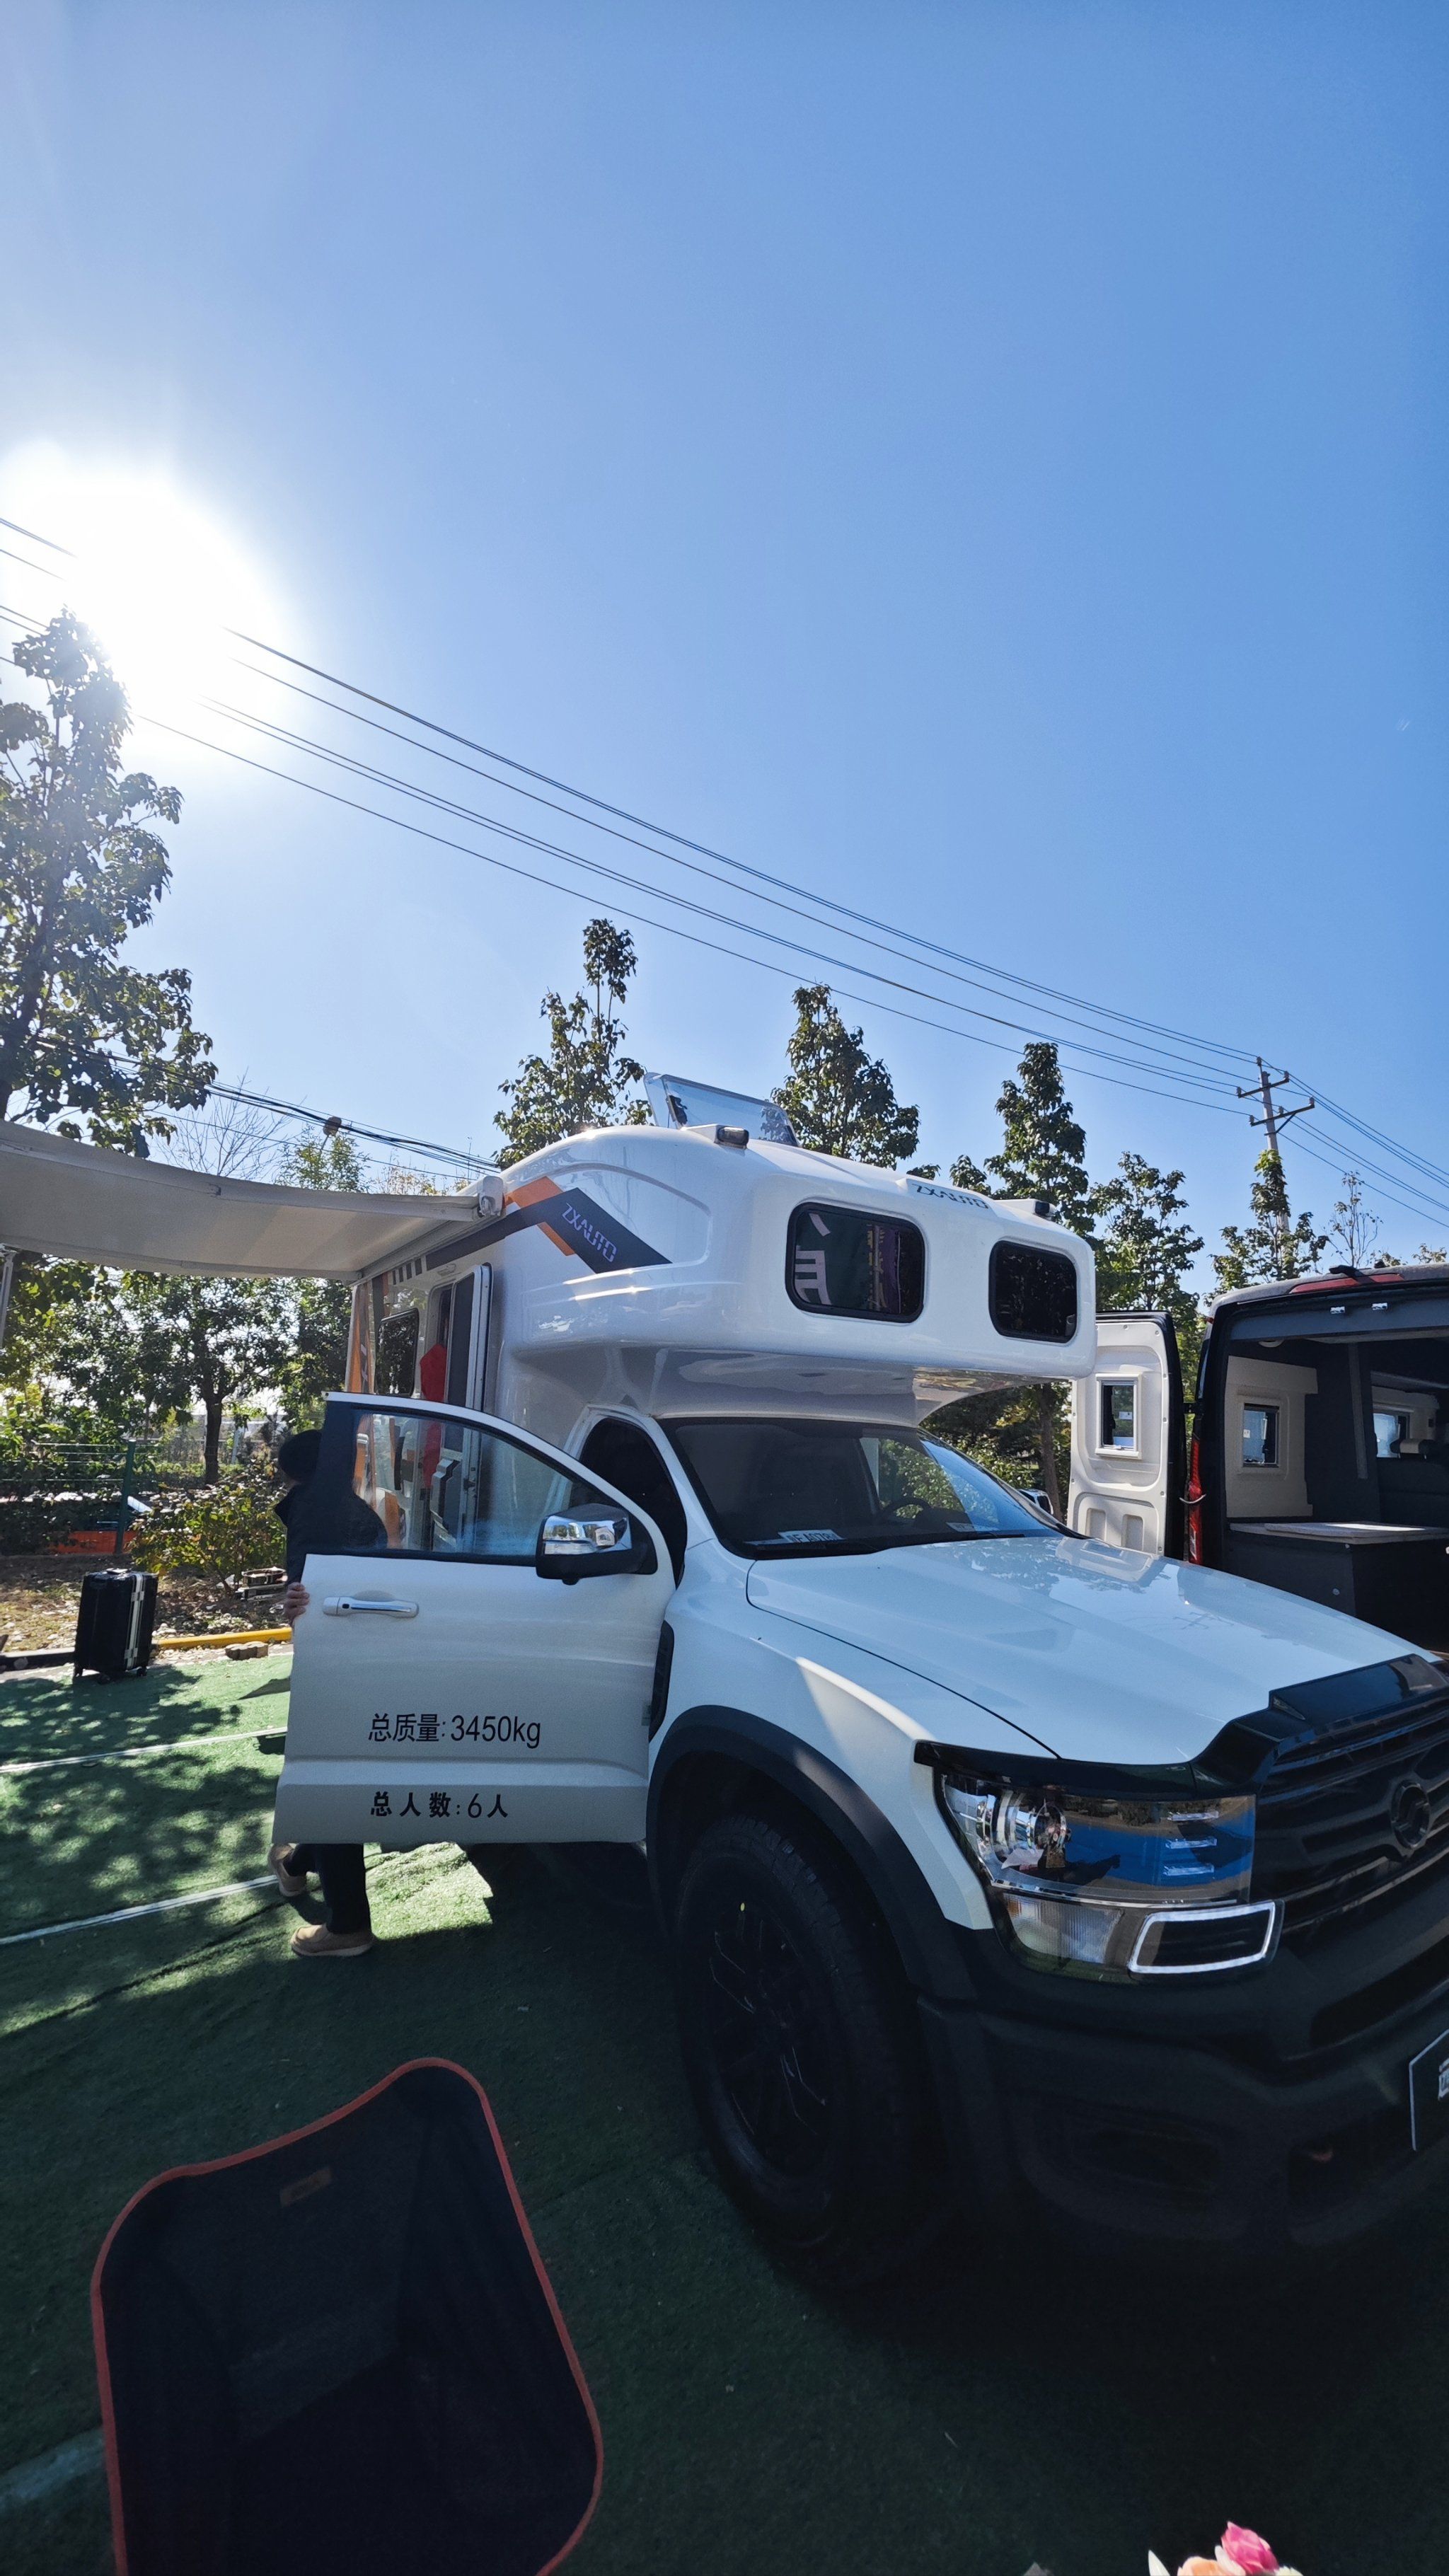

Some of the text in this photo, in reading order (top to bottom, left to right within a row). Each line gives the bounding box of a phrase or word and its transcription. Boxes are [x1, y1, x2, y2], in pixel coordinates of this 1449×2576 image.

[912, 1184, 988, 1209] ZXAUTO
[562, 1202, 617, 1262] ZXAUTO
[368, 1713, 541, 1749] 总质量:3450kg
[371, 1791, 508, 1818] 总人数:6人
